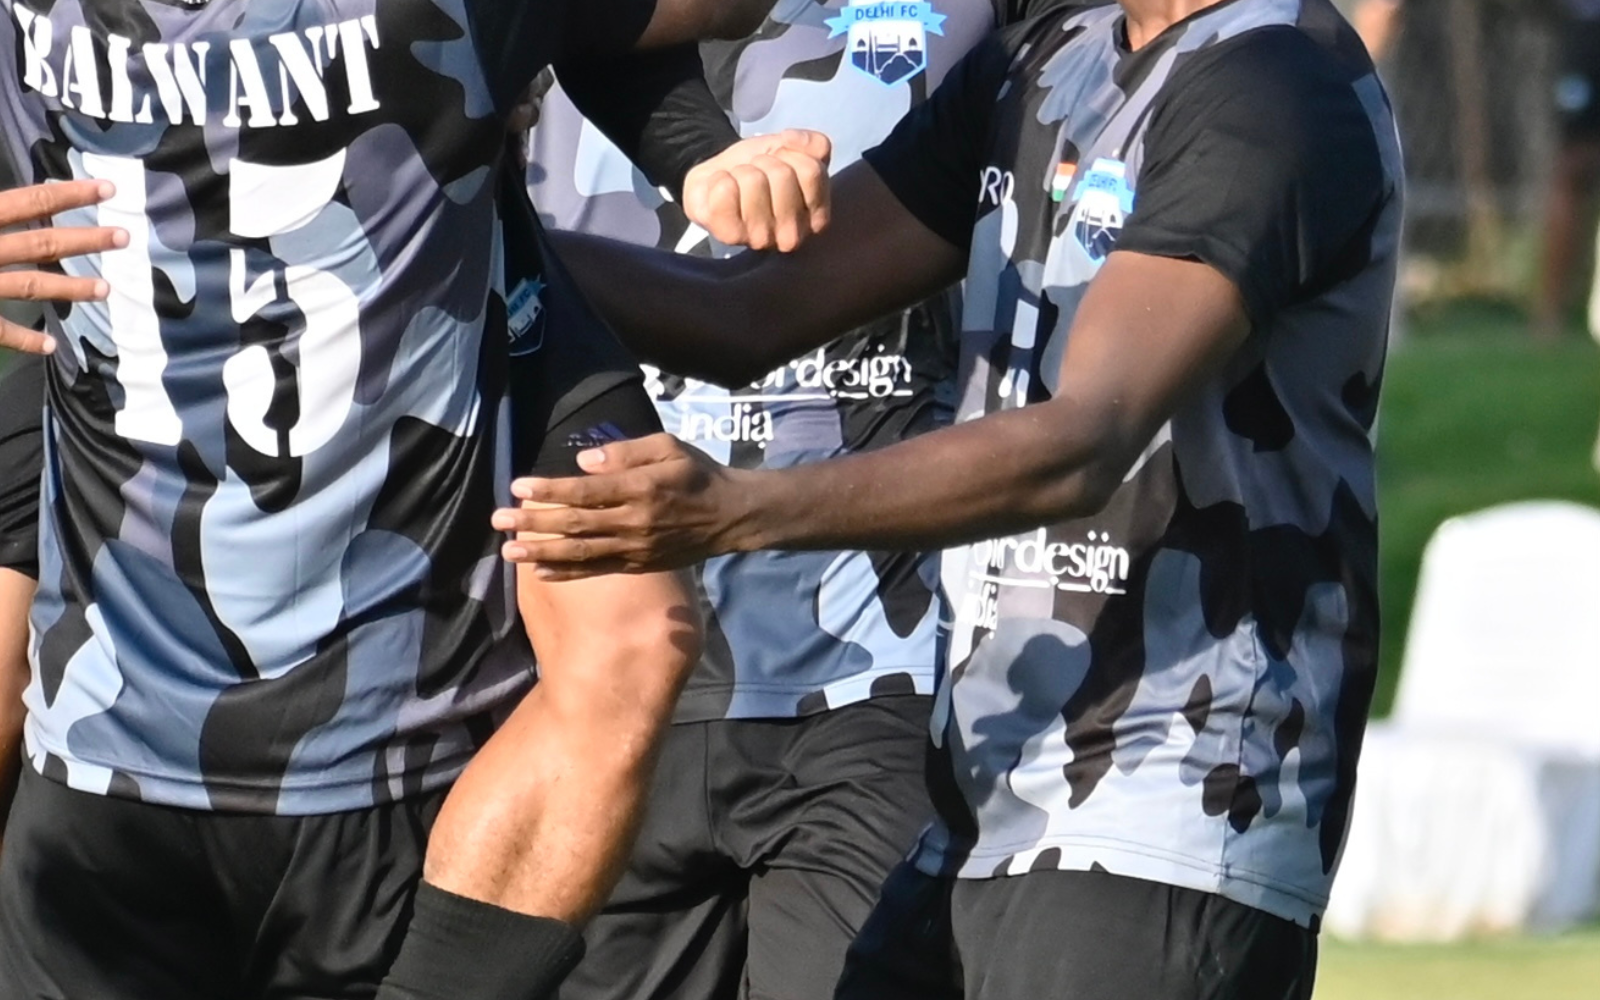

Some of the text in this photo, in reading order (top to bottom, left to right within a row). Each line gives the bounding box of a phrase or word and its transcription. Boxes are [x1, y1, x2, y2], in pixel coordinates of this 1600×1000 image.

[855, 4, 919, 21] DELHI FC
[13, 2, 381, 127] BALWANT
[80, 146, 362, 459] 15
[678, 402, 774, 449] india
